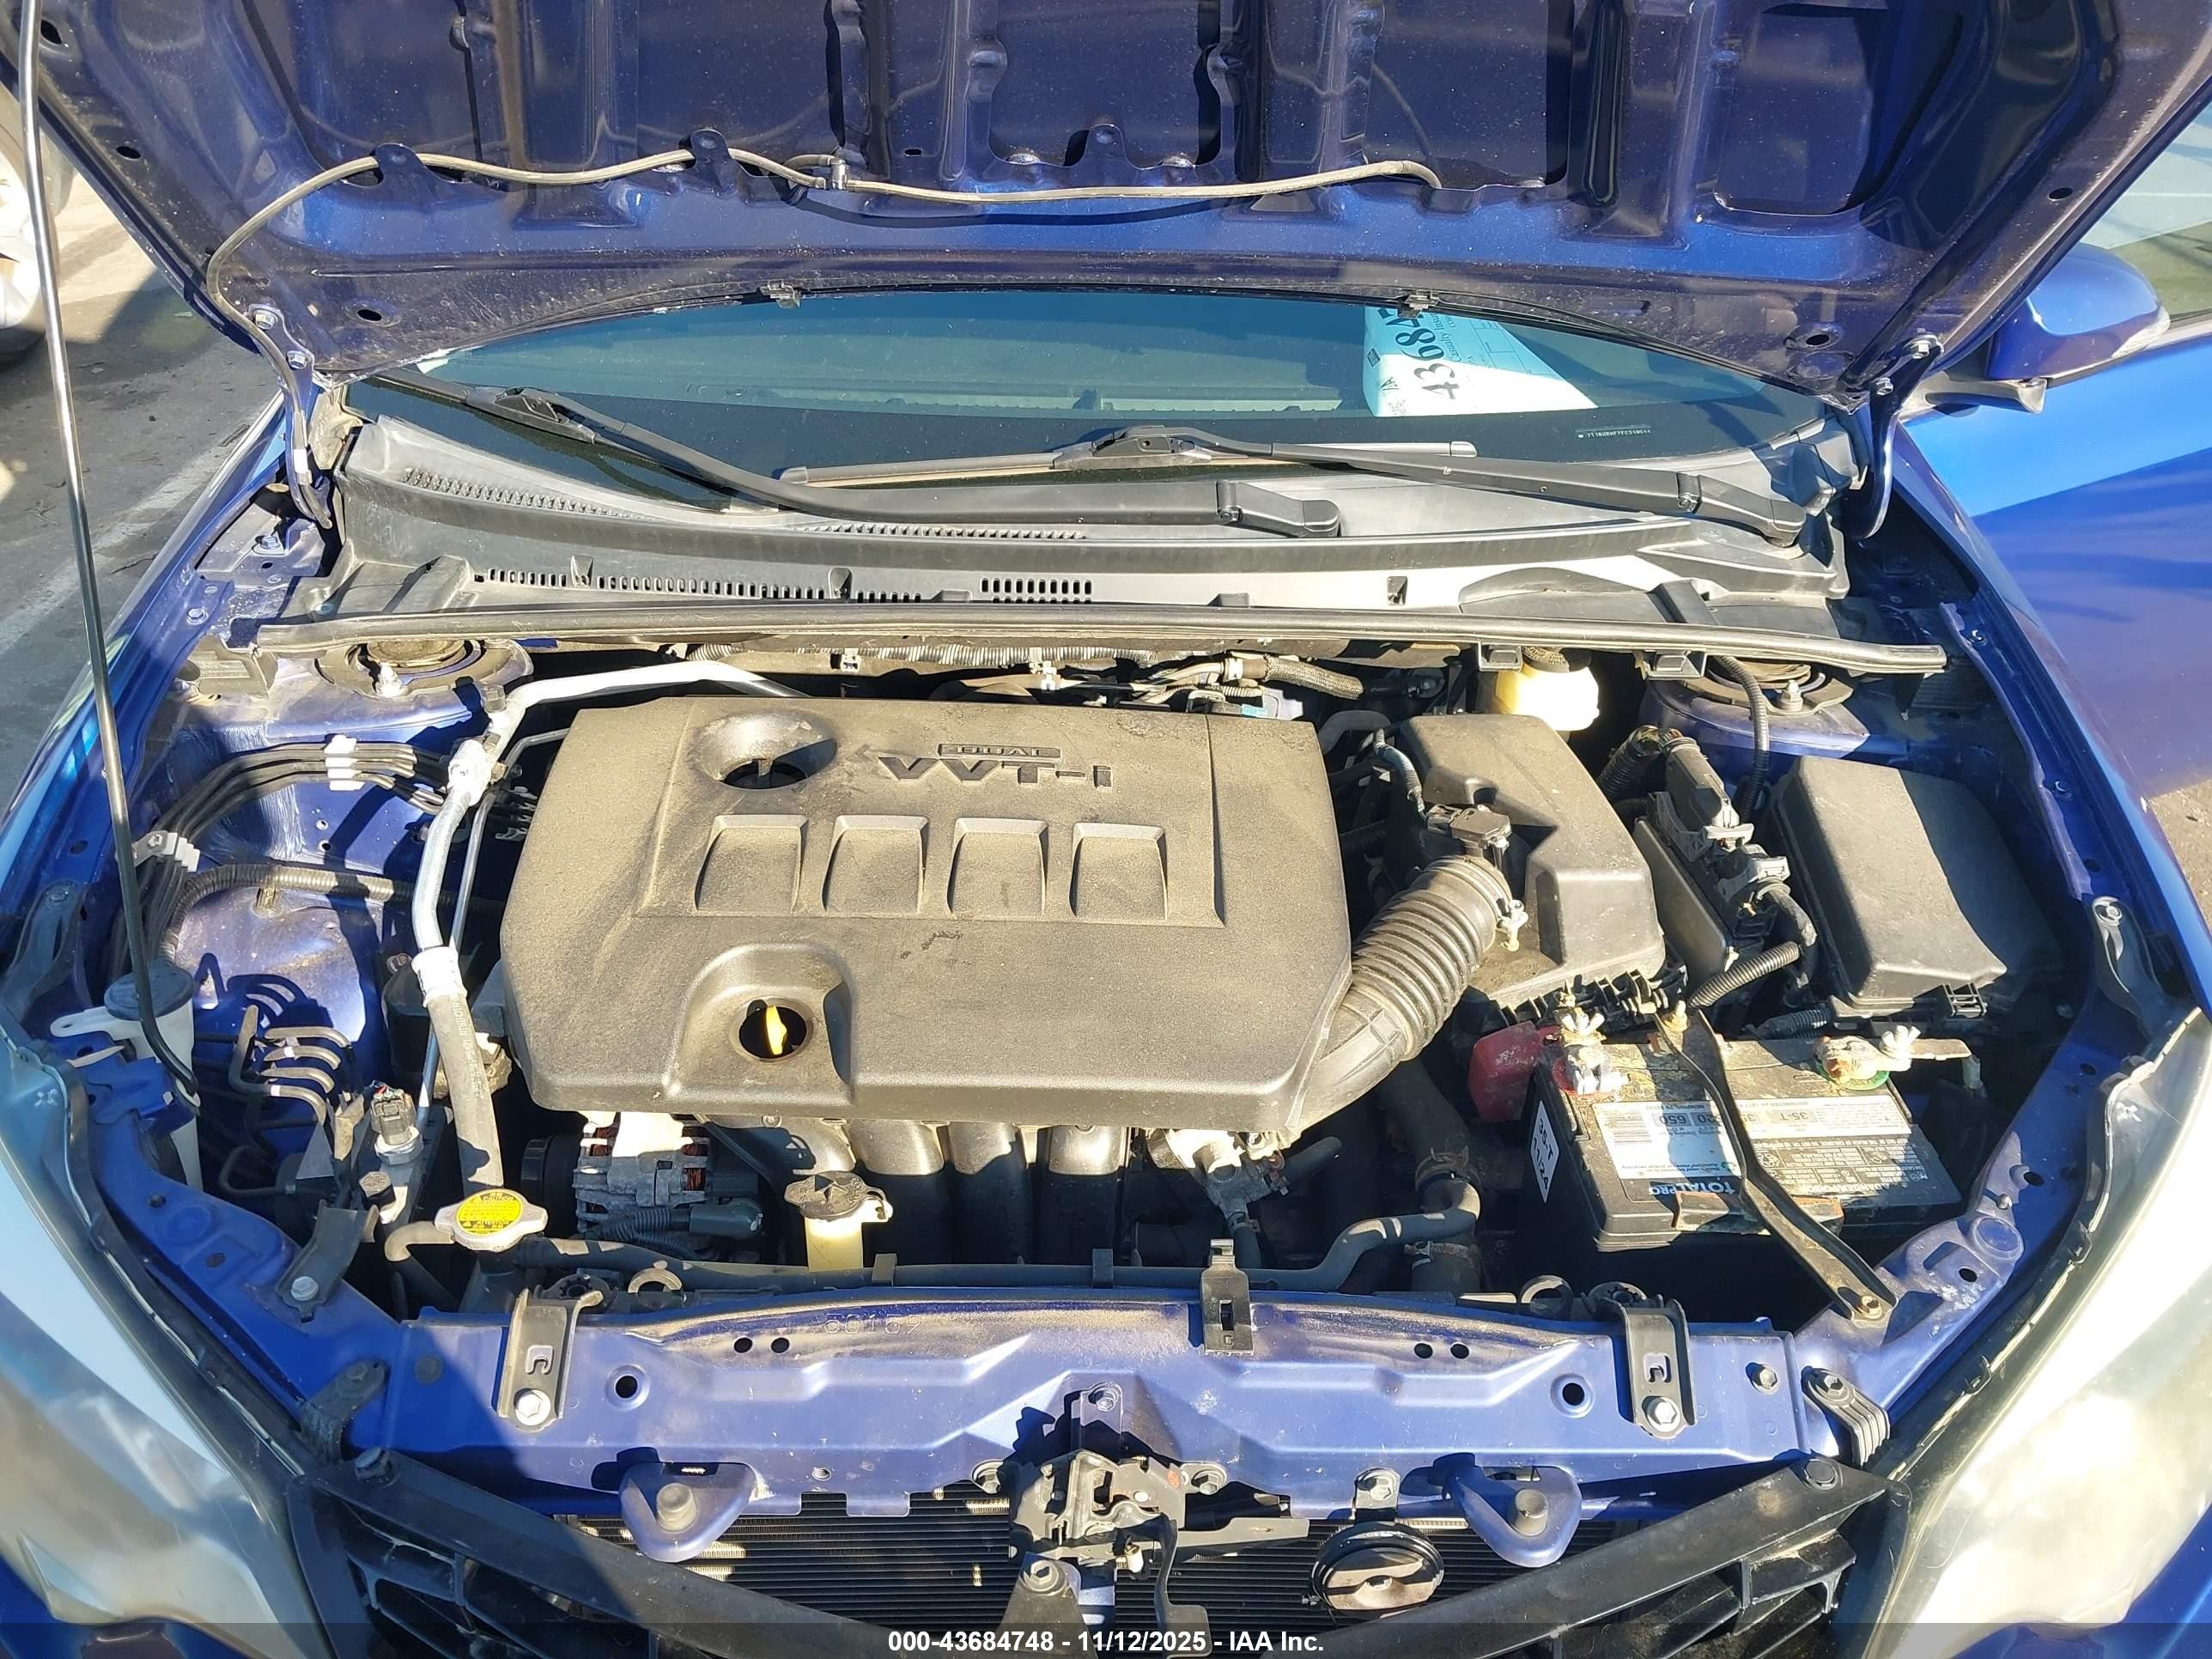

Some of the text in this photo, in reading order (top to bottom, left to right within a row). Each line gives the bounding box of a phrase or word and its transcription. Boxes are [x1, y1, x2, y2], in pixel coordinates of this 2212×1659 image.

[1377, 307, 1460, 400] 43684
[1659, 1114, 1686, 1125] 650
[1779, 1112, 1808, 1121] 35-T
